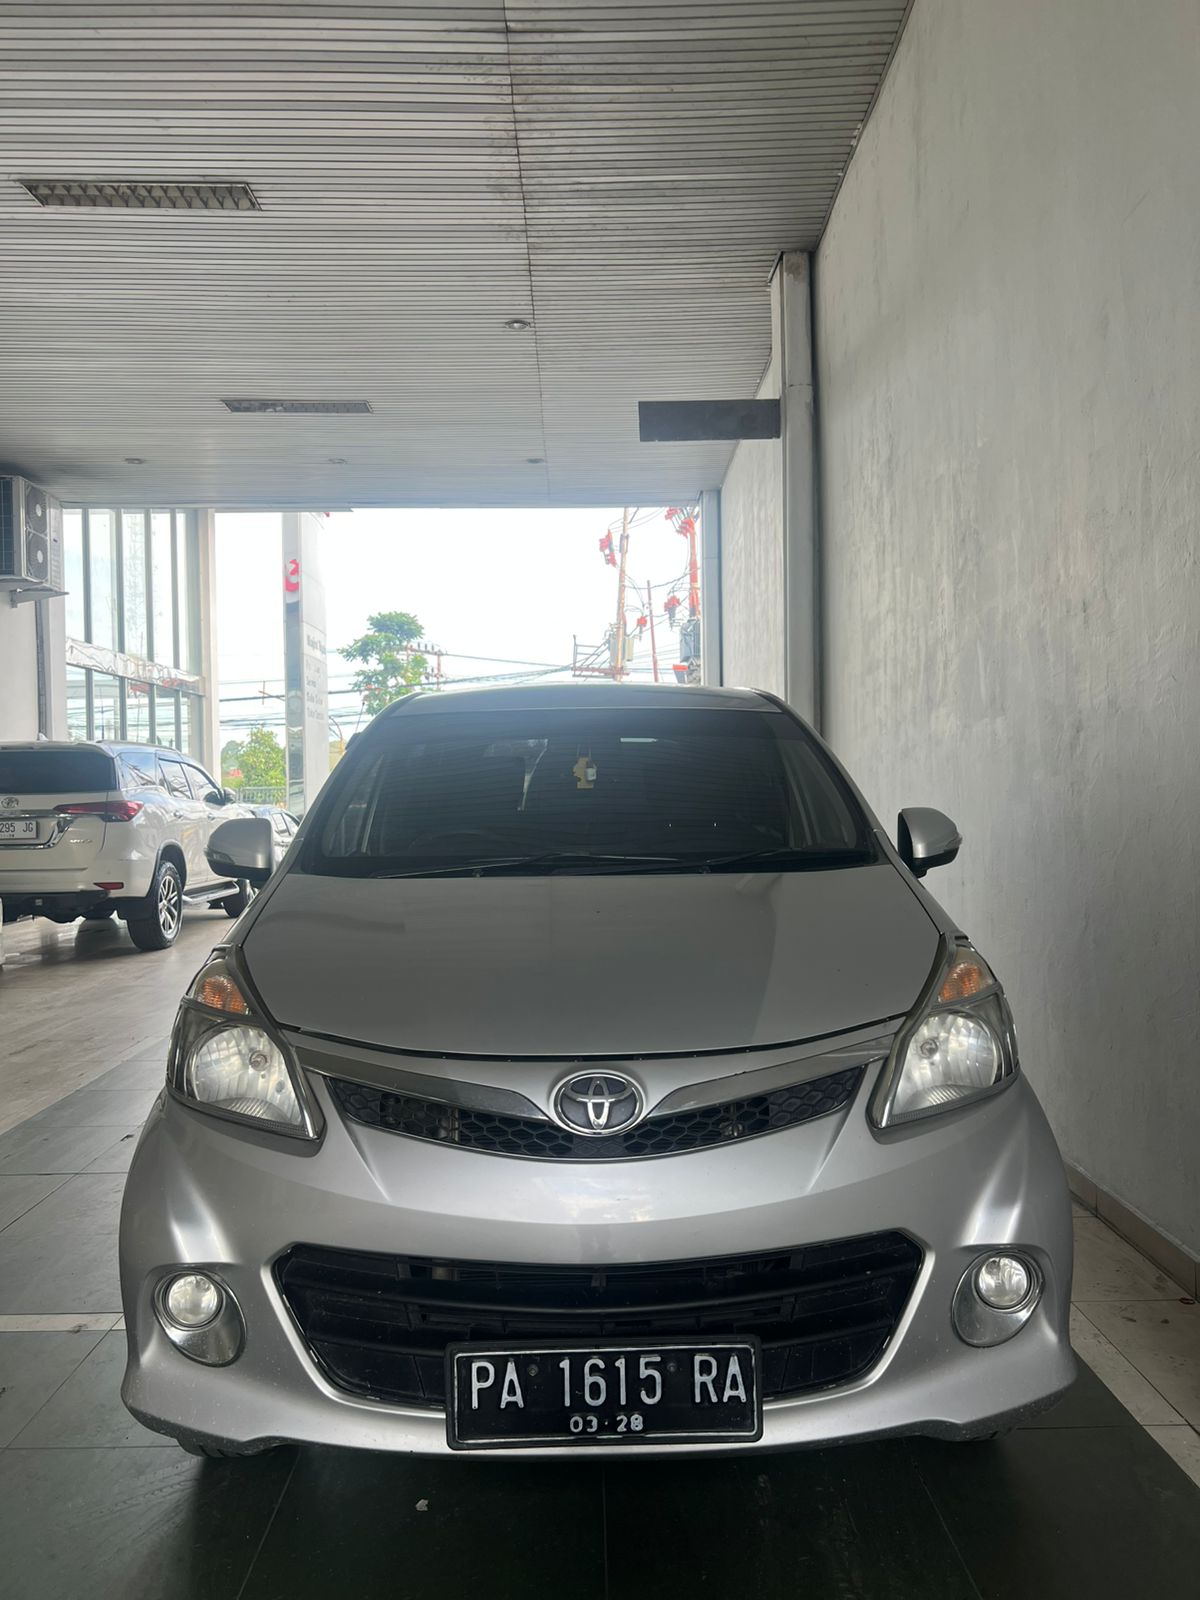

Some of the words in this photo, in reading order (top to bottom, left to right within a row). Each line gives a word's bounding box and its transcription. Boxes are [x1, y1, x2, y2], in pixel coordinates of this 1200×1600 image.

[22, 822, 34, 832] JG
[471, 1361, 525, 1410] PA
[558, 1356, 663, 1407] 1615
[693, 1354, 748, 1403] RA
